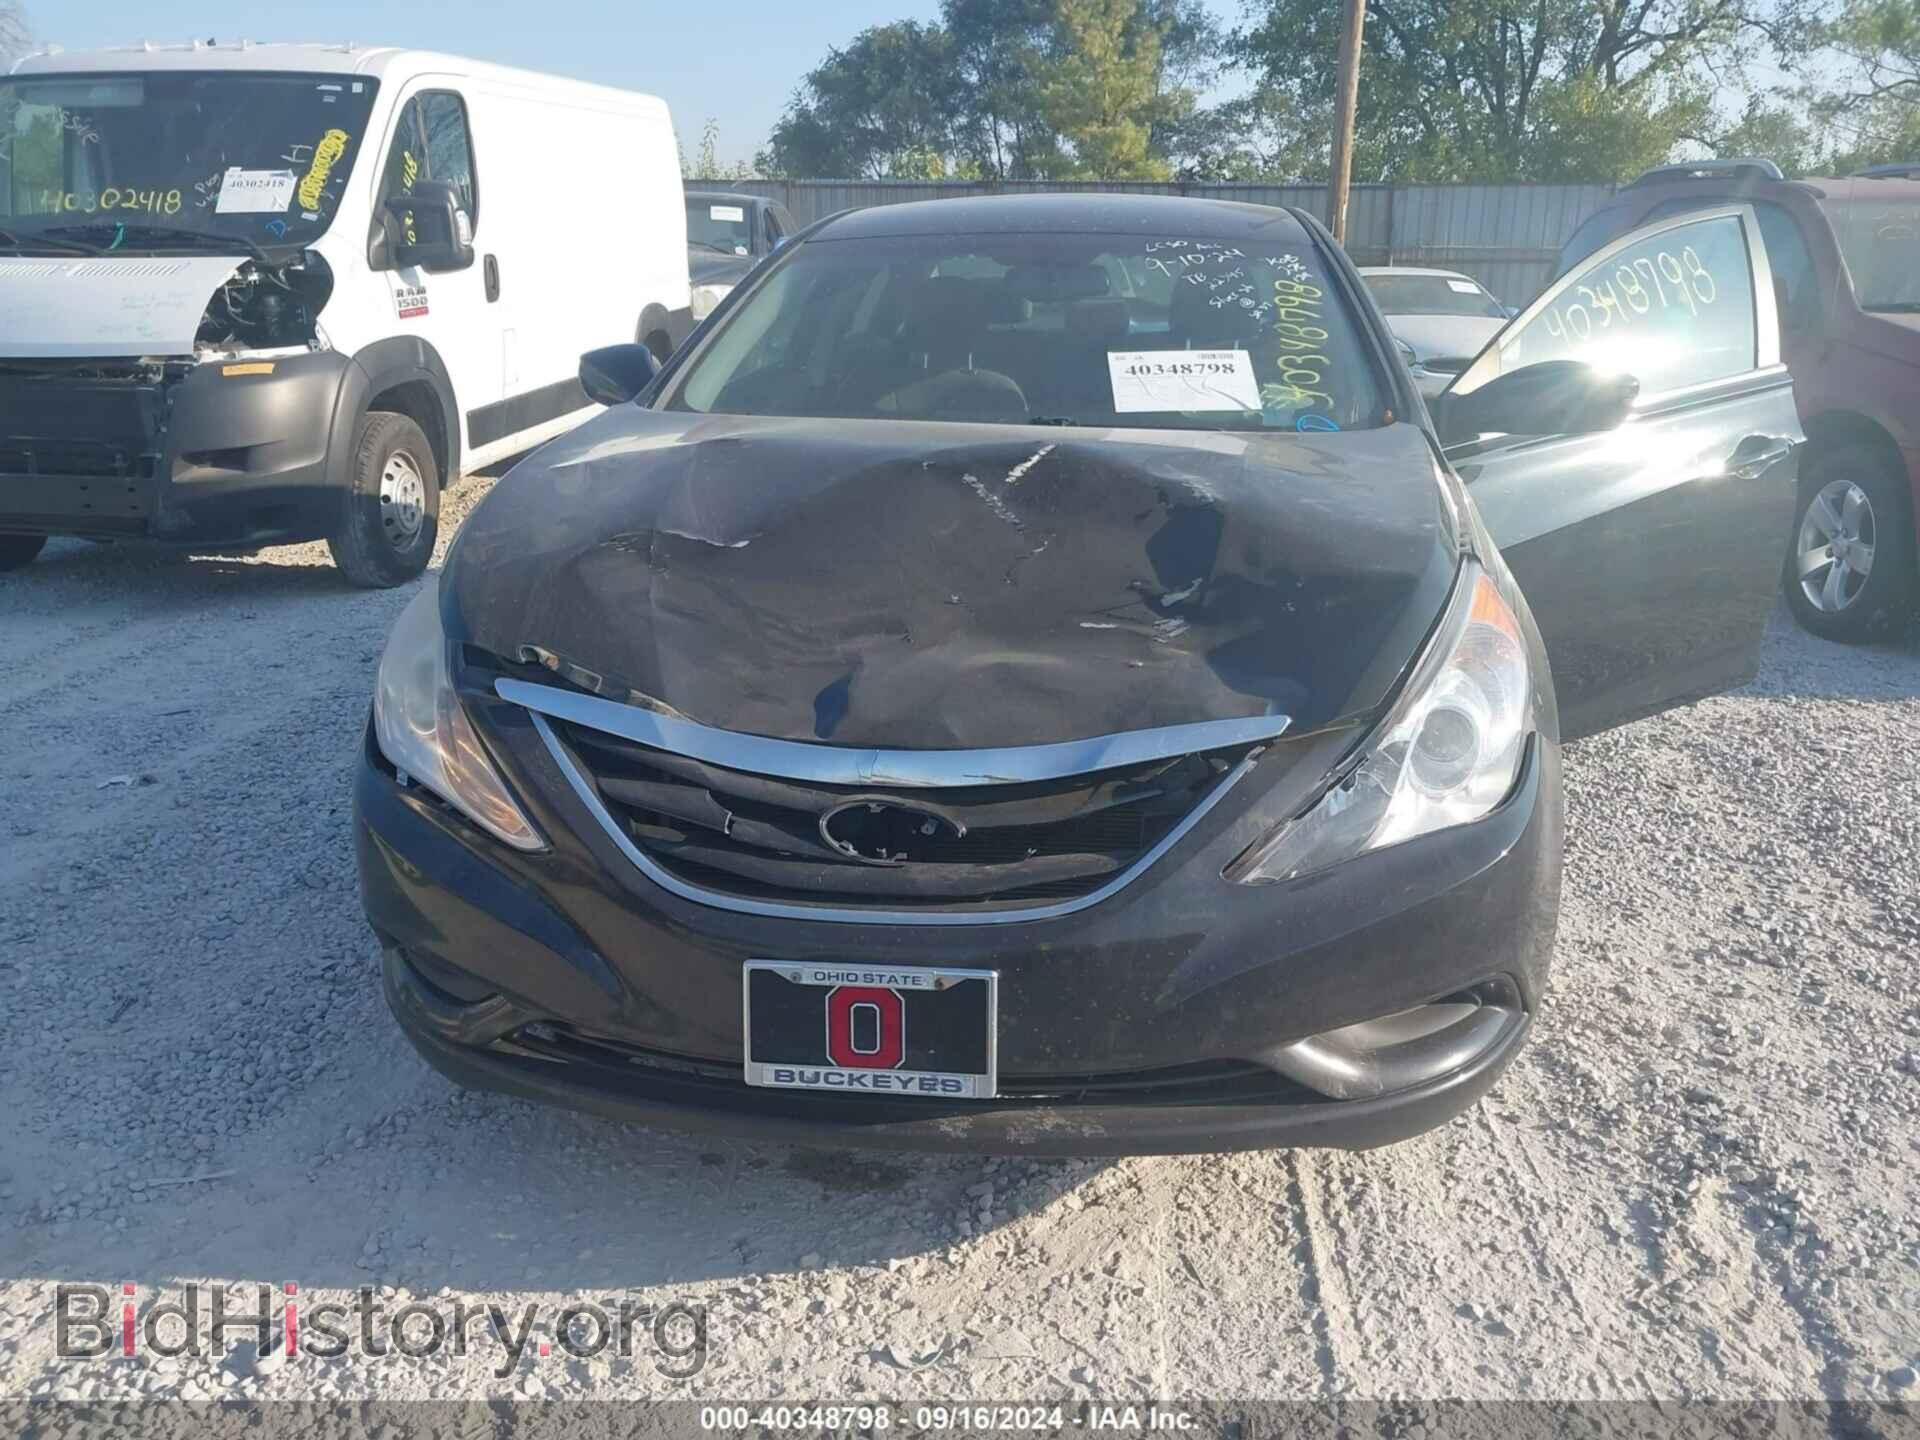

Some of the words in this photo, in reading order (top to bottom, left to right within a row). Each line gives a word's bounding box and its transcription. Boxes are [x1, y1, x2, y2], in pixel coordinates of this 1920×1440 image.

[230, 179, 285, 189] 40302418
[396, 286, 427, 298] RAM
[1544, 246, 1716, 345] 40348798
[397, 296, 429, 308] 1500
[1125, 363, 1236, 376] 40348798
[813, 970, 858, 983] OHIO
[863, 973, 923, 987] STATE
[773, 1068, 963, 1094] BUCKEYES
